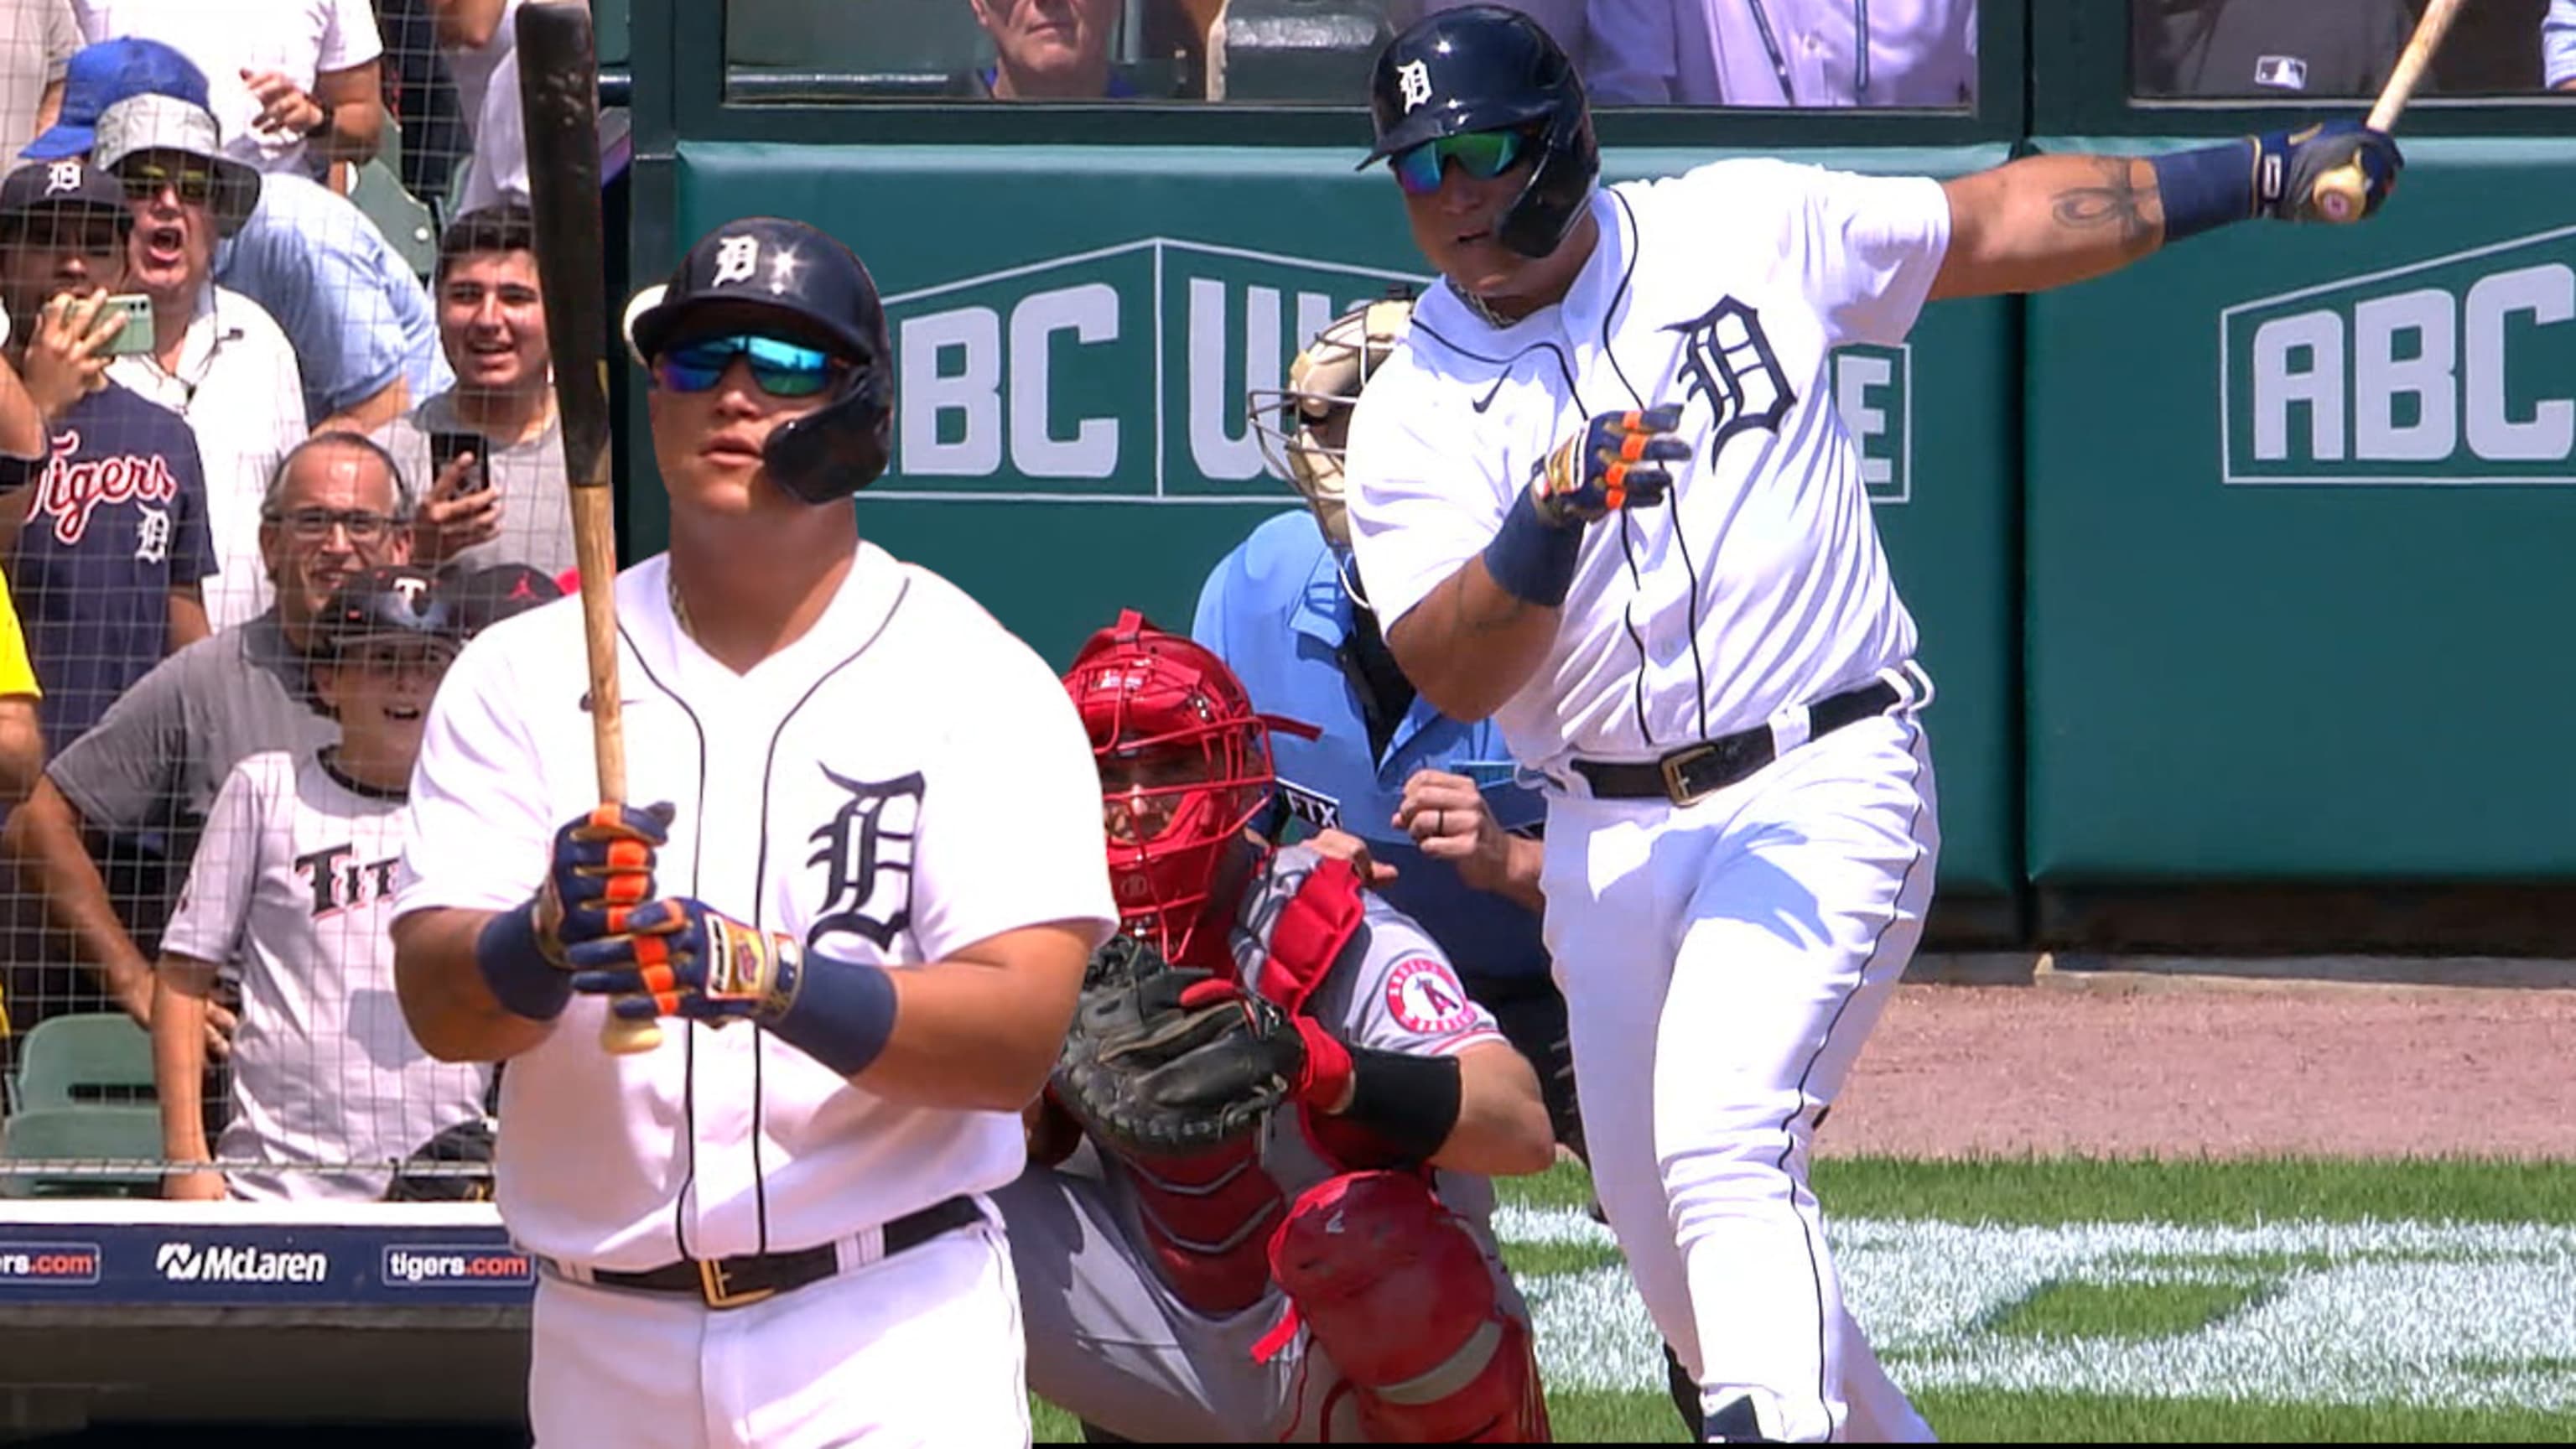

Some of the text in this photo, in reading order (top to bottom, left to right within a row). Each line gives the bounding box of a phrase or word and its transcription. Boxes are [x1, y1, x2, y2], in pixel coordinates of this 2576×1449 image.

[882, 283, 1120, 479] BC
[2253, 262, 2576, 460] ABC
[1285, 788, 1339, 829] FTX
[294, 841, 401, 918] TIT
[0, 1254, 93, 1275] rs.com
[201, 1245, 328, 1281] McLaren
[389, 1252, 527, 1283] tigers.com
